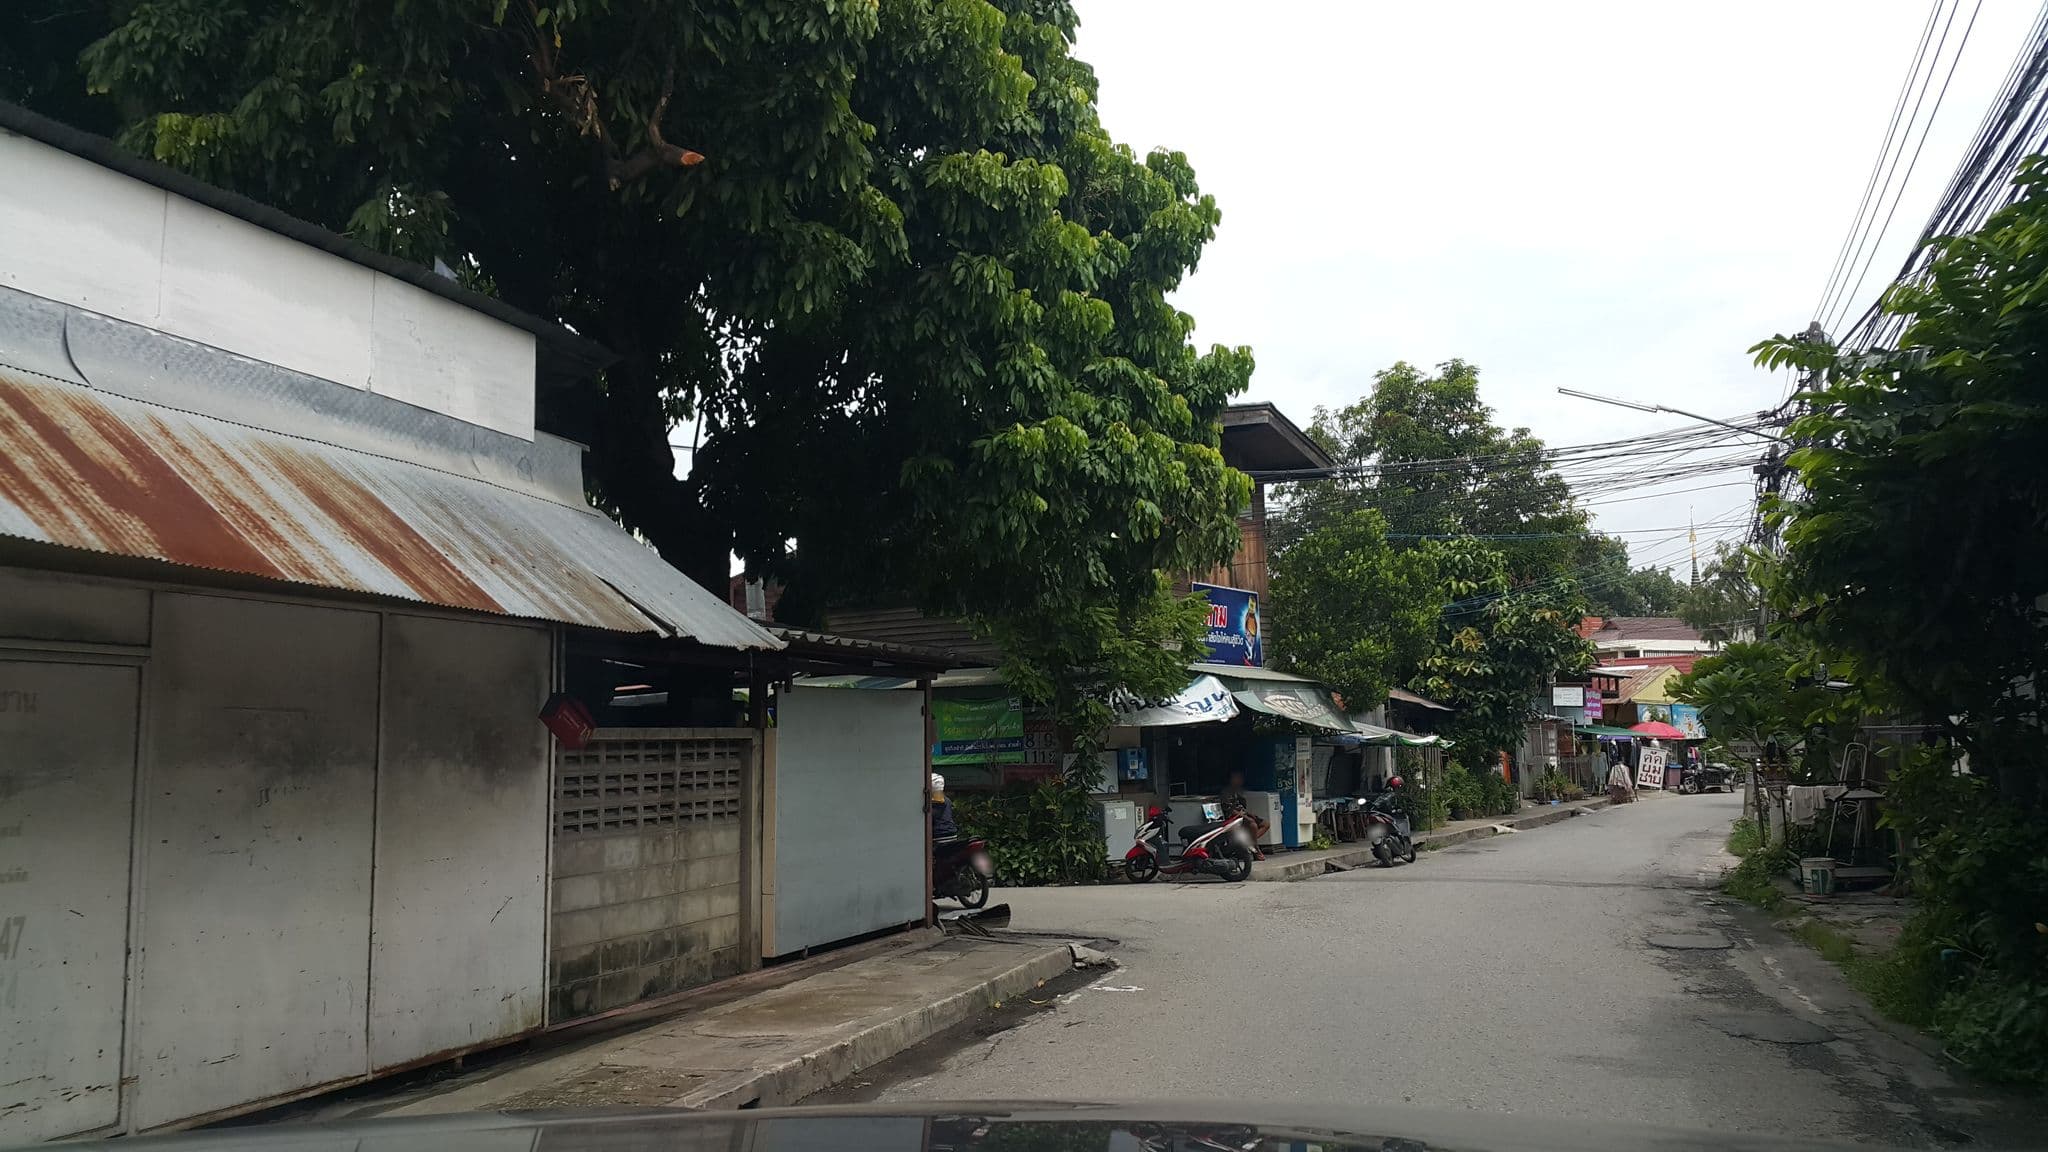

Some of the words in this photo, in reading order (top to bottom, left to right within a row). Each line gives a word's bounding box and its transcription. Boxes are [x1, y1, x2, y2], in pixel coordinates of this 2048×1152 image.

[1643, 751, 1662, 764] ตัด
[1641, 764, 1661, 775] ผม
[1639, 773, 1661, 785] ชาย
